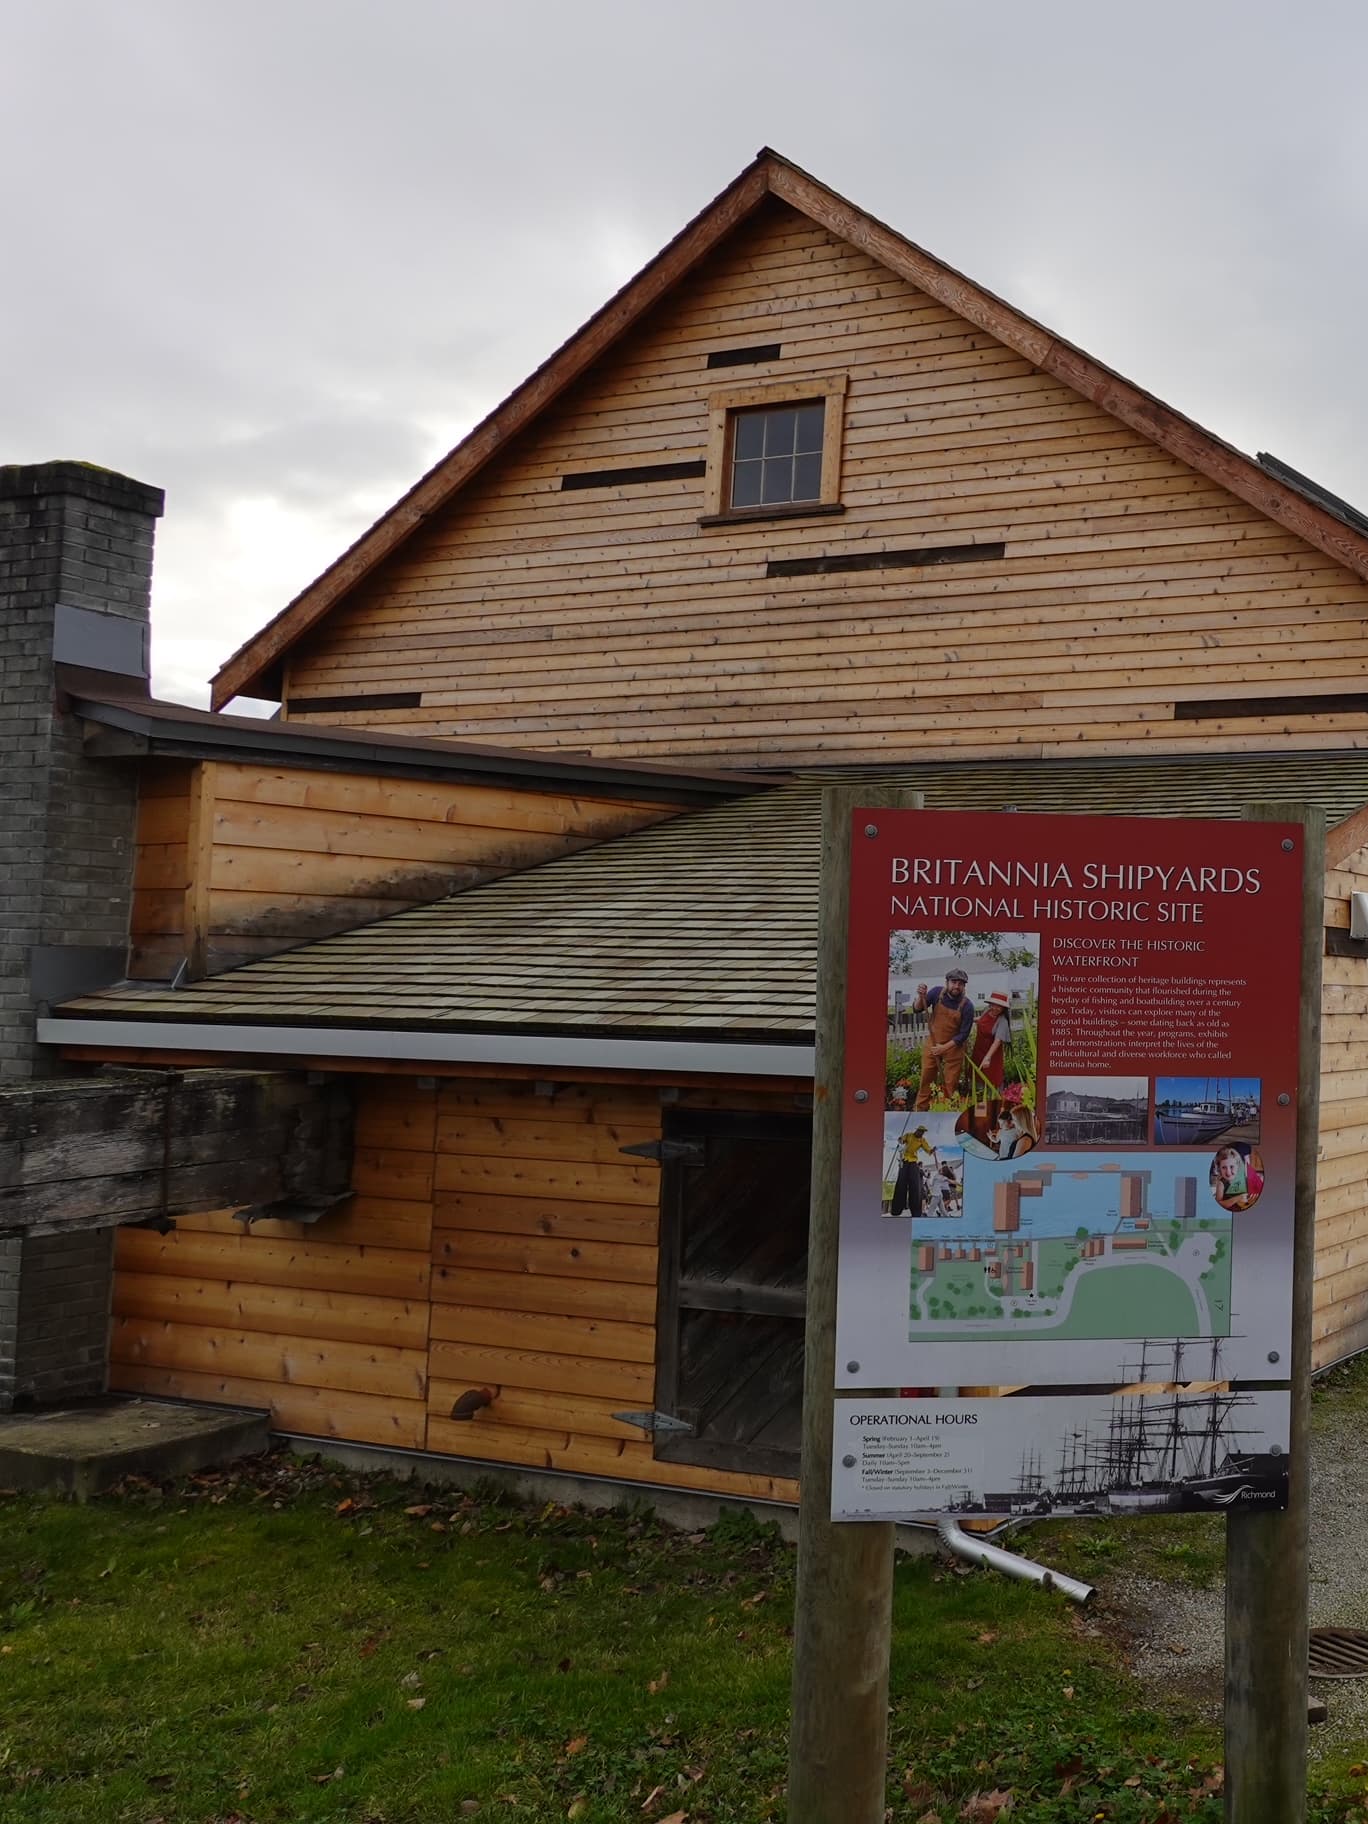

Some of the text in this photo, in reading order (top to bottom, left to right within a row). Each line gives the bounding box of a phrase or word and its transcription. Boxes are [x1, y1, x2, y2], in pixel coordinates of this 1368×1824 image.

[892, 858, 1261, 895] BRITANNIA SHIPYARDS
[891, 896, 1204, 923] NATIONAL HISTORIC SITE
[1053, 938, 1206, 951] DISCOVER THE HISTORIC
[1052, 955, 1139, 967] WATERFRONT
[1088, 975, 1126, 984] collection
[1138, 976, 1169, 985] heritage
[1171, 977, 1206, 985] buildings
[1192, 988, 1217, 997] during
[1092, 997, 1117, 1006] fishing
[1136, 998, 1185, 1007] boatbuilding
[1070, 1007, 1096, 1016] Today,
[1144, 1009, 1173, 1017] explore
[1051, 1018, 1080, 1026] original
[1083, 1018, 1119, 1027] buildings
[1150, 1019, 1174, 1028] dating
[1076, 1029, 1120, 1038] Throughout
[1067, 1039, 1126, 1047] demonstrations
[1128, 1040, 1160, 1049] interpret
[1148, 1051, 1187, 1059] workforce
[850, 1414, 978, 1425] OPERATIONAL HOURS
